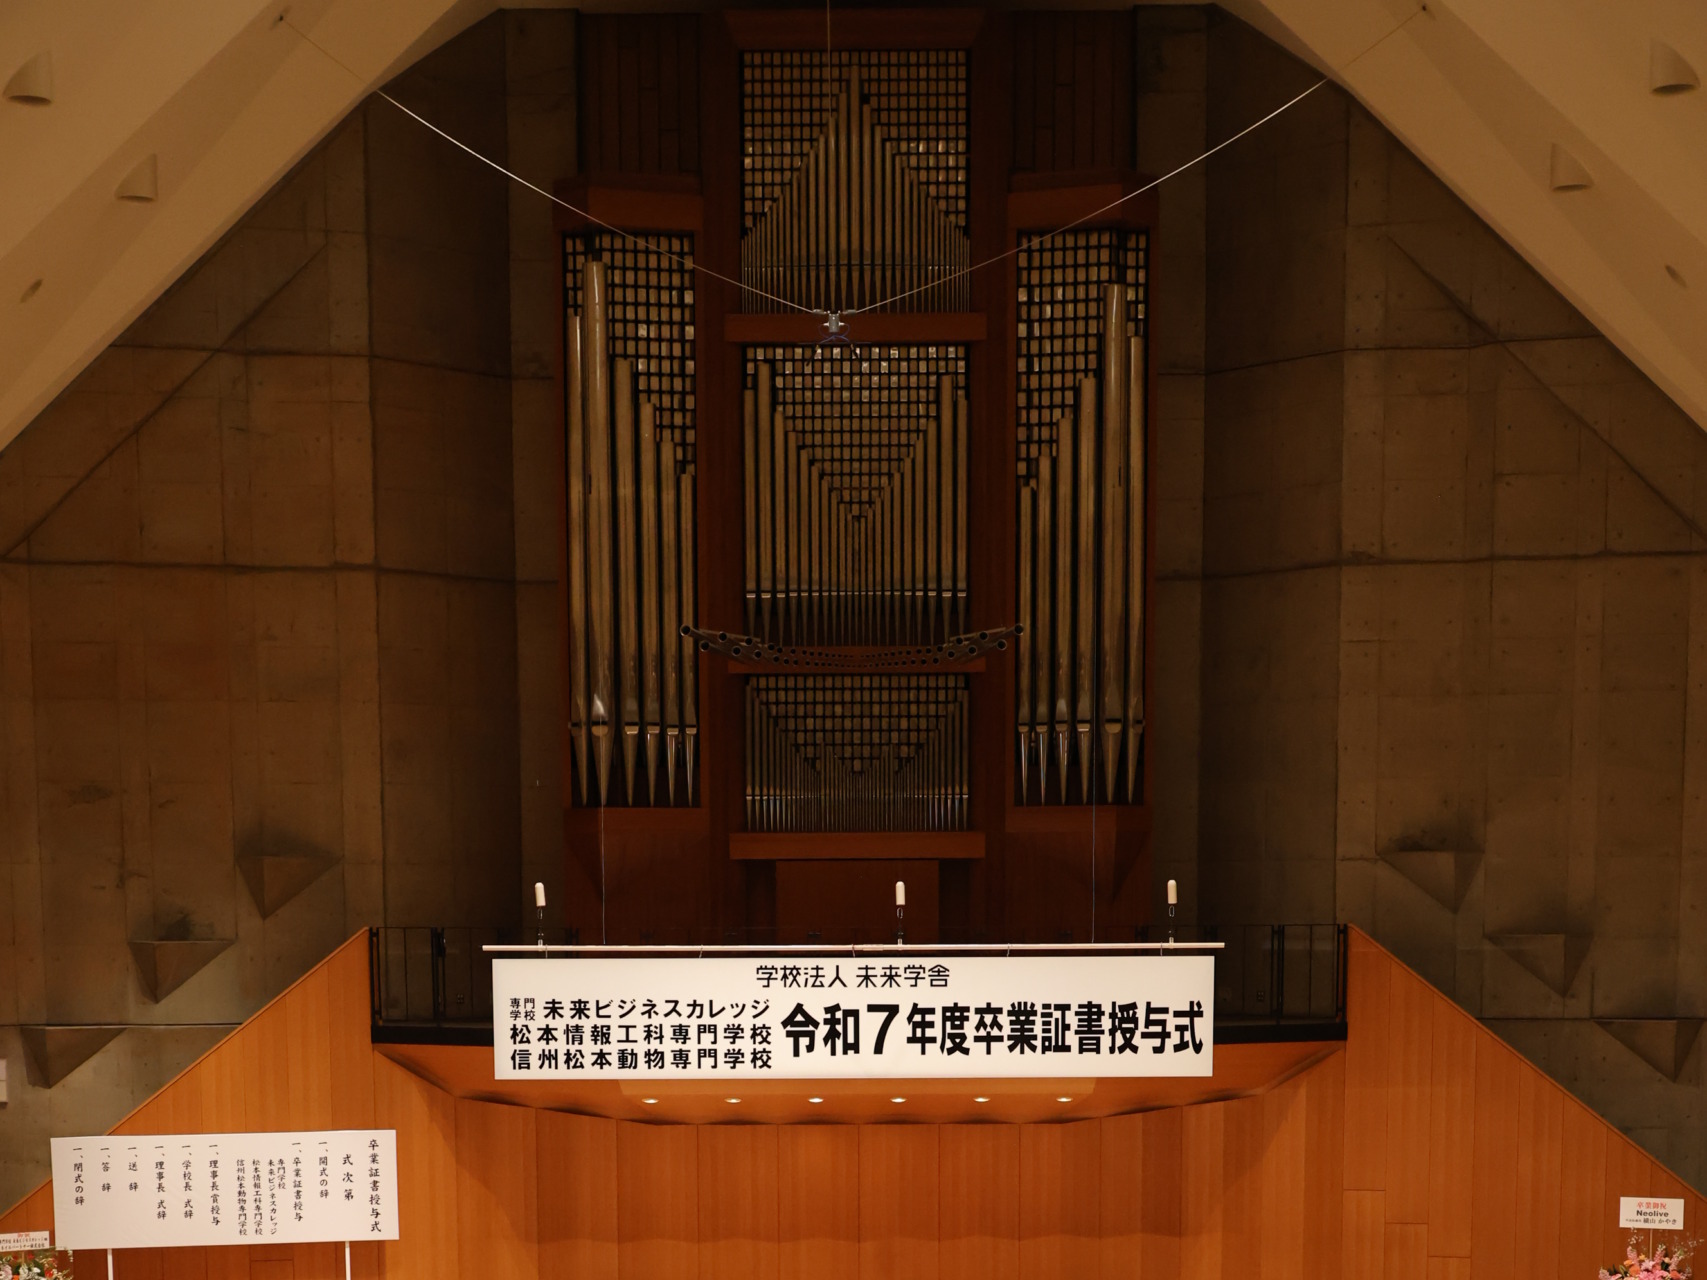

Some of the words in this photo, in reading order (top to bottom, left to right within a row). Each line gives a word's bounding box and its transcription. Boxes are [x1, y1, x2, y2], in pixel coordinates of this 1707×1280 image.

[755, 965, 848, 989] 学校法人
[855, 964, 950, 989] 未来学舎
[509, 997, 536, 1009] 専門
[542, 998, 770, 1021] 未来ビジネスカレッジ
[509, 1009, 536, 1022] 学校
[509, 1023, 772, 1046] 松本情報工科専門学校
[780, 1000, 1205, 1057] 令和7年度卒業証書授与式
[510, 1048, 772, 1071] 信州松本動物専門学校
[342, 1153, 354, 1202] 式次第
[367, 1138, 382, 1233] 卒業証書授与式
